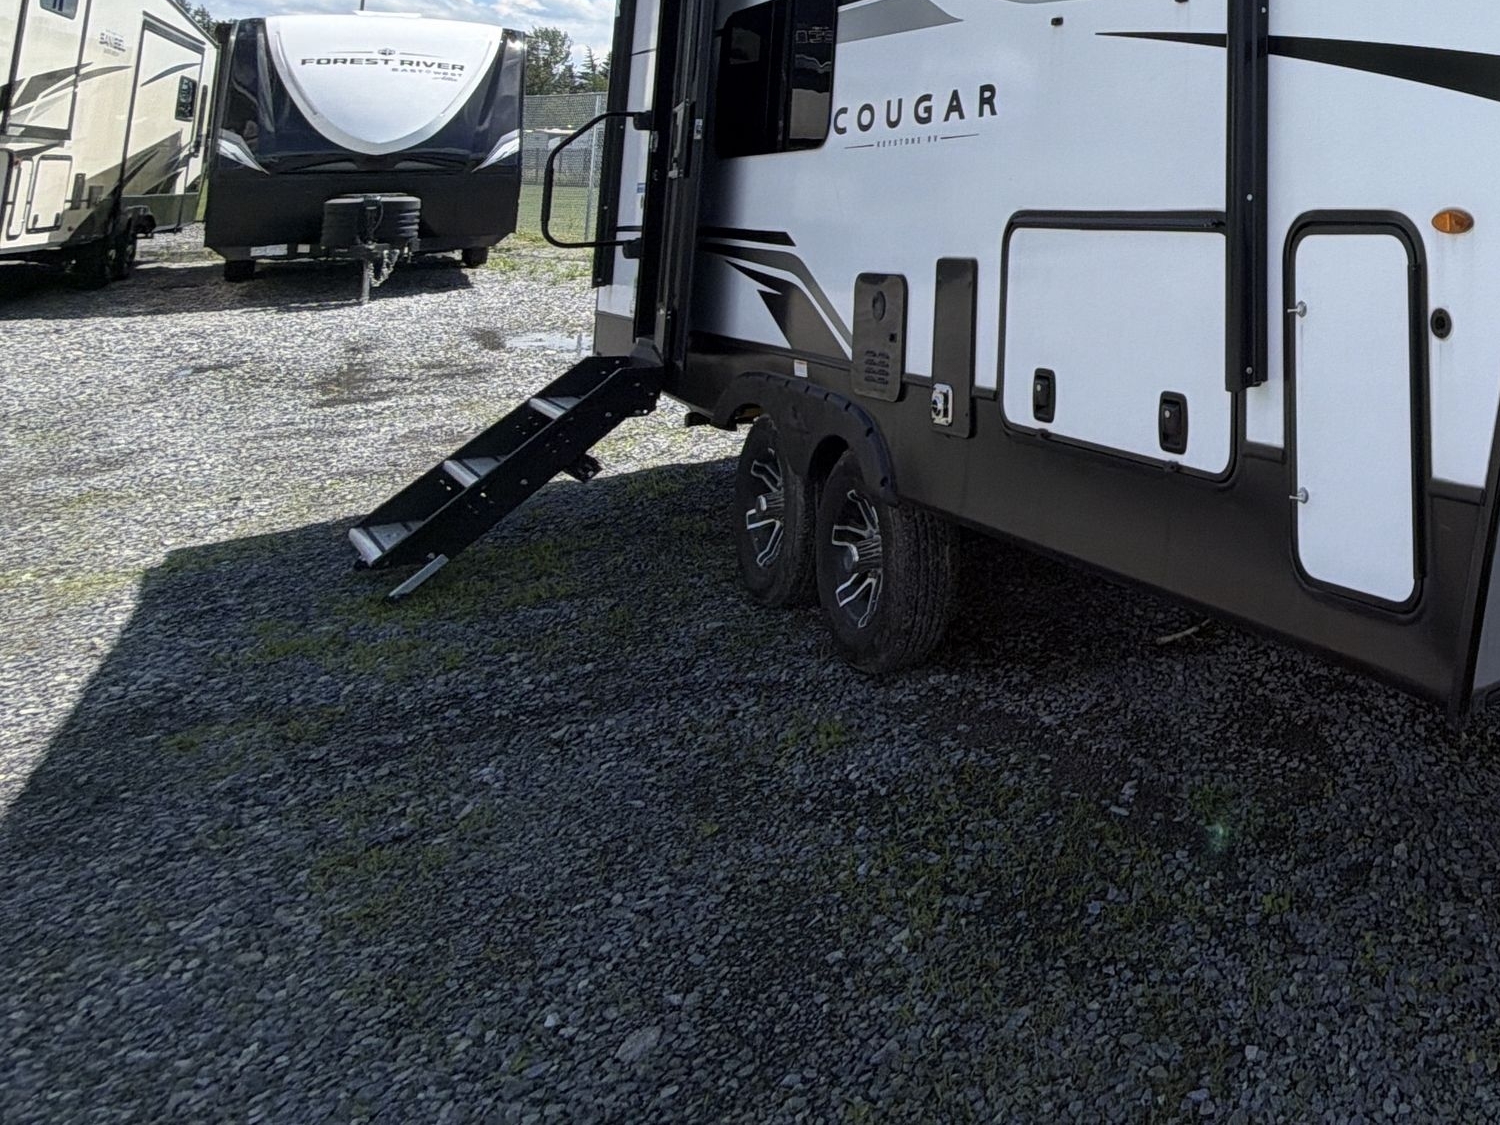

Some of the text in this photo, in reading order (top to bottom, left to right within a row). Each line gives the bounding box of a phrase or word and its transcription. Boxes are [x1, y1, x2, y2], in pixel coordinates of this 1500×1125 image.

[400, 59, 464, 71] RIVER
[833, 83, 998, 135] COUGAR
[876, 136, 921, 148] KEYSTONE
